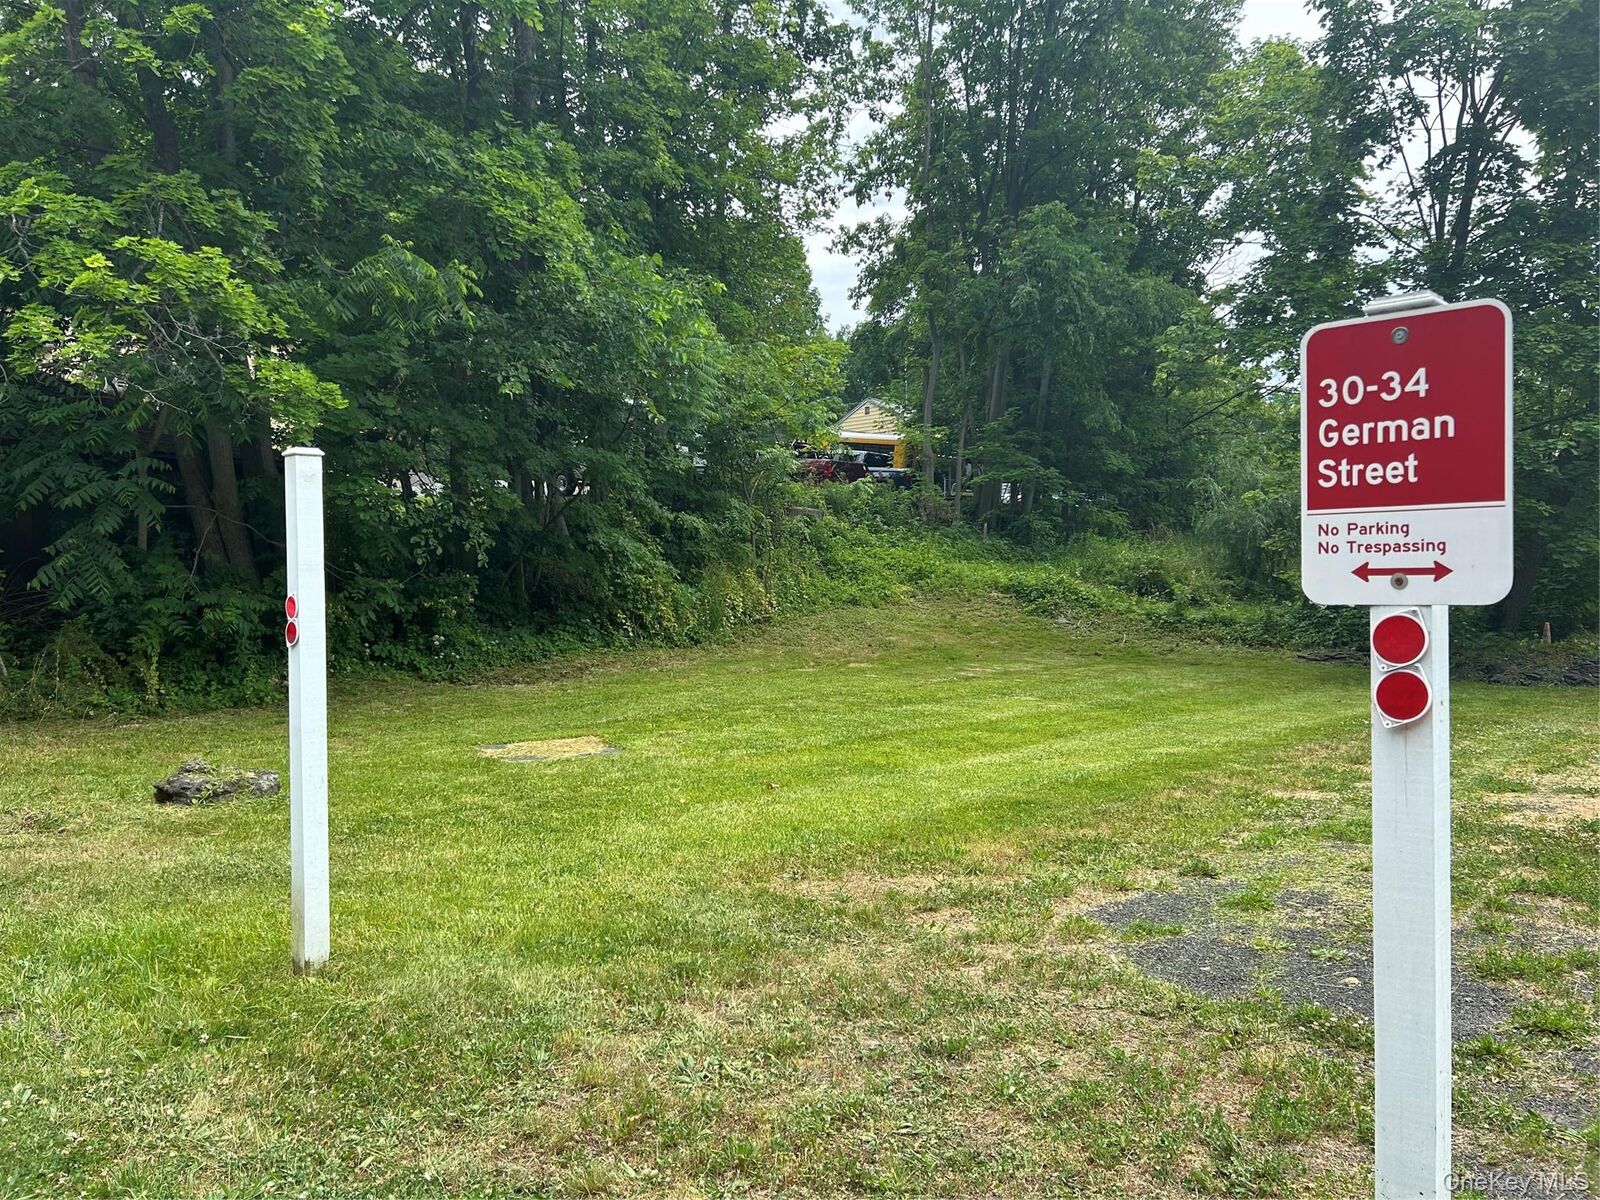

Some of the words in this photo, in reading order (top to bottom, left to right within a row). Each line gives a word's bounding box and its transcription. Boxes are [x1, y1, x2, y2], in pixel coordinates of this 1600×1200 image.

[1318, 367, 1429, 408] 30-34
[1318, 414, 1455, 448] German
[1317, 453, 1418, 488] Street
[1318, 523, 1339, 537] No
[1347, 520, 1410, 538] Parking
[1318, 541, 1339, 554] No
[1347, 538, 1447, 555] Trespassing
